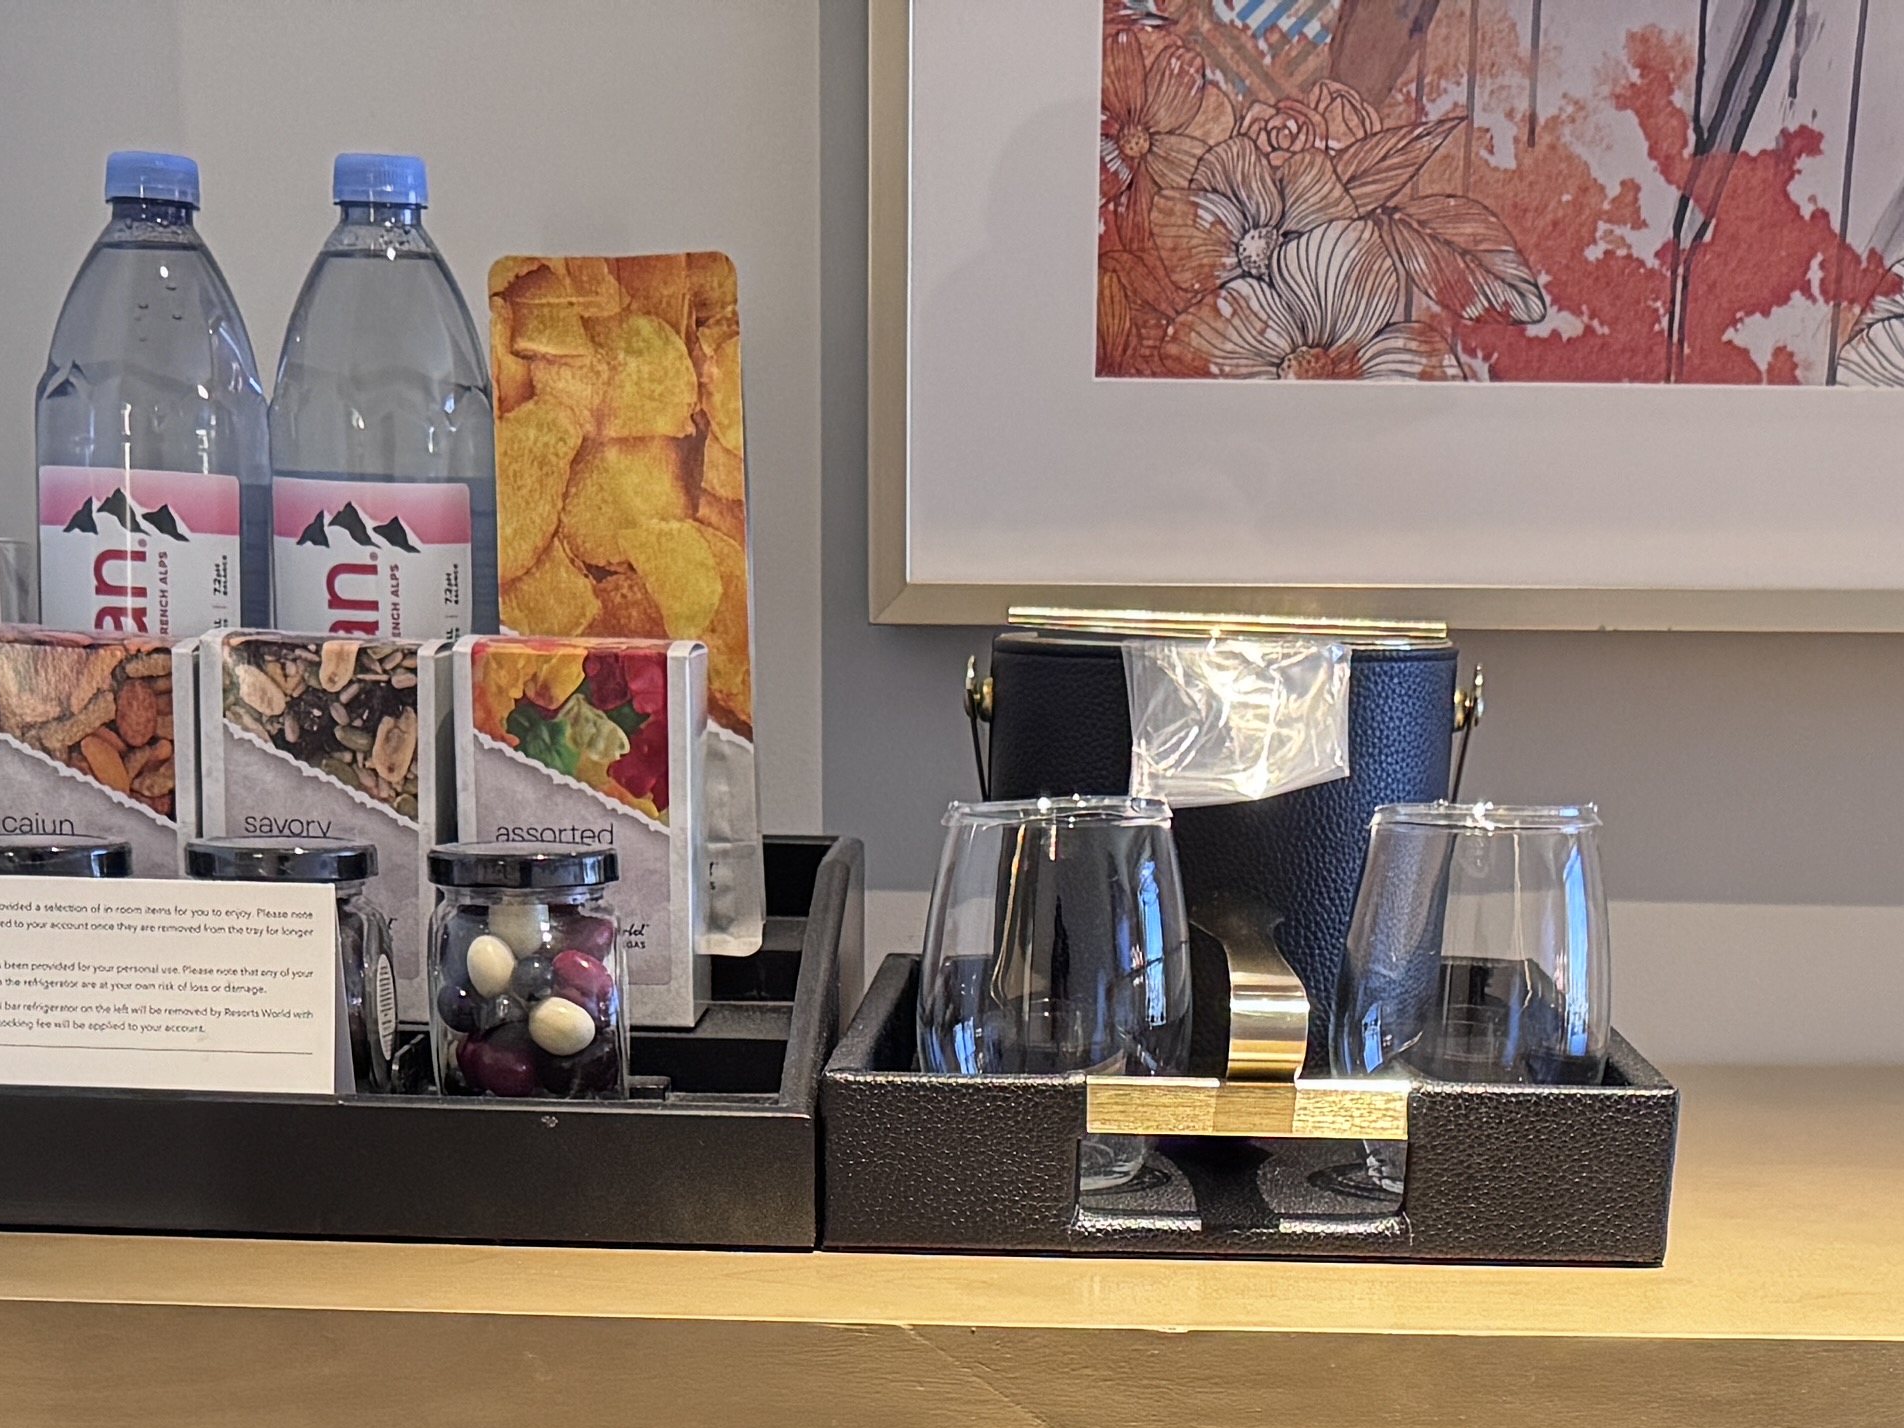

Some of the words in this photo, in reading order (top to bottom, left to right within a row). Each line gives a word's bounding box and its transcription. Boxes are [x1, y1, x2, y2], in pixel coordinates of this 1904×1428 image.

[496, 822, 614, 845] assorted
[91, 903, 100, 913] of
[212, 909, 222, 917] to
[14, 920, 24, 928] to
[280, 967, 289, 978] of
